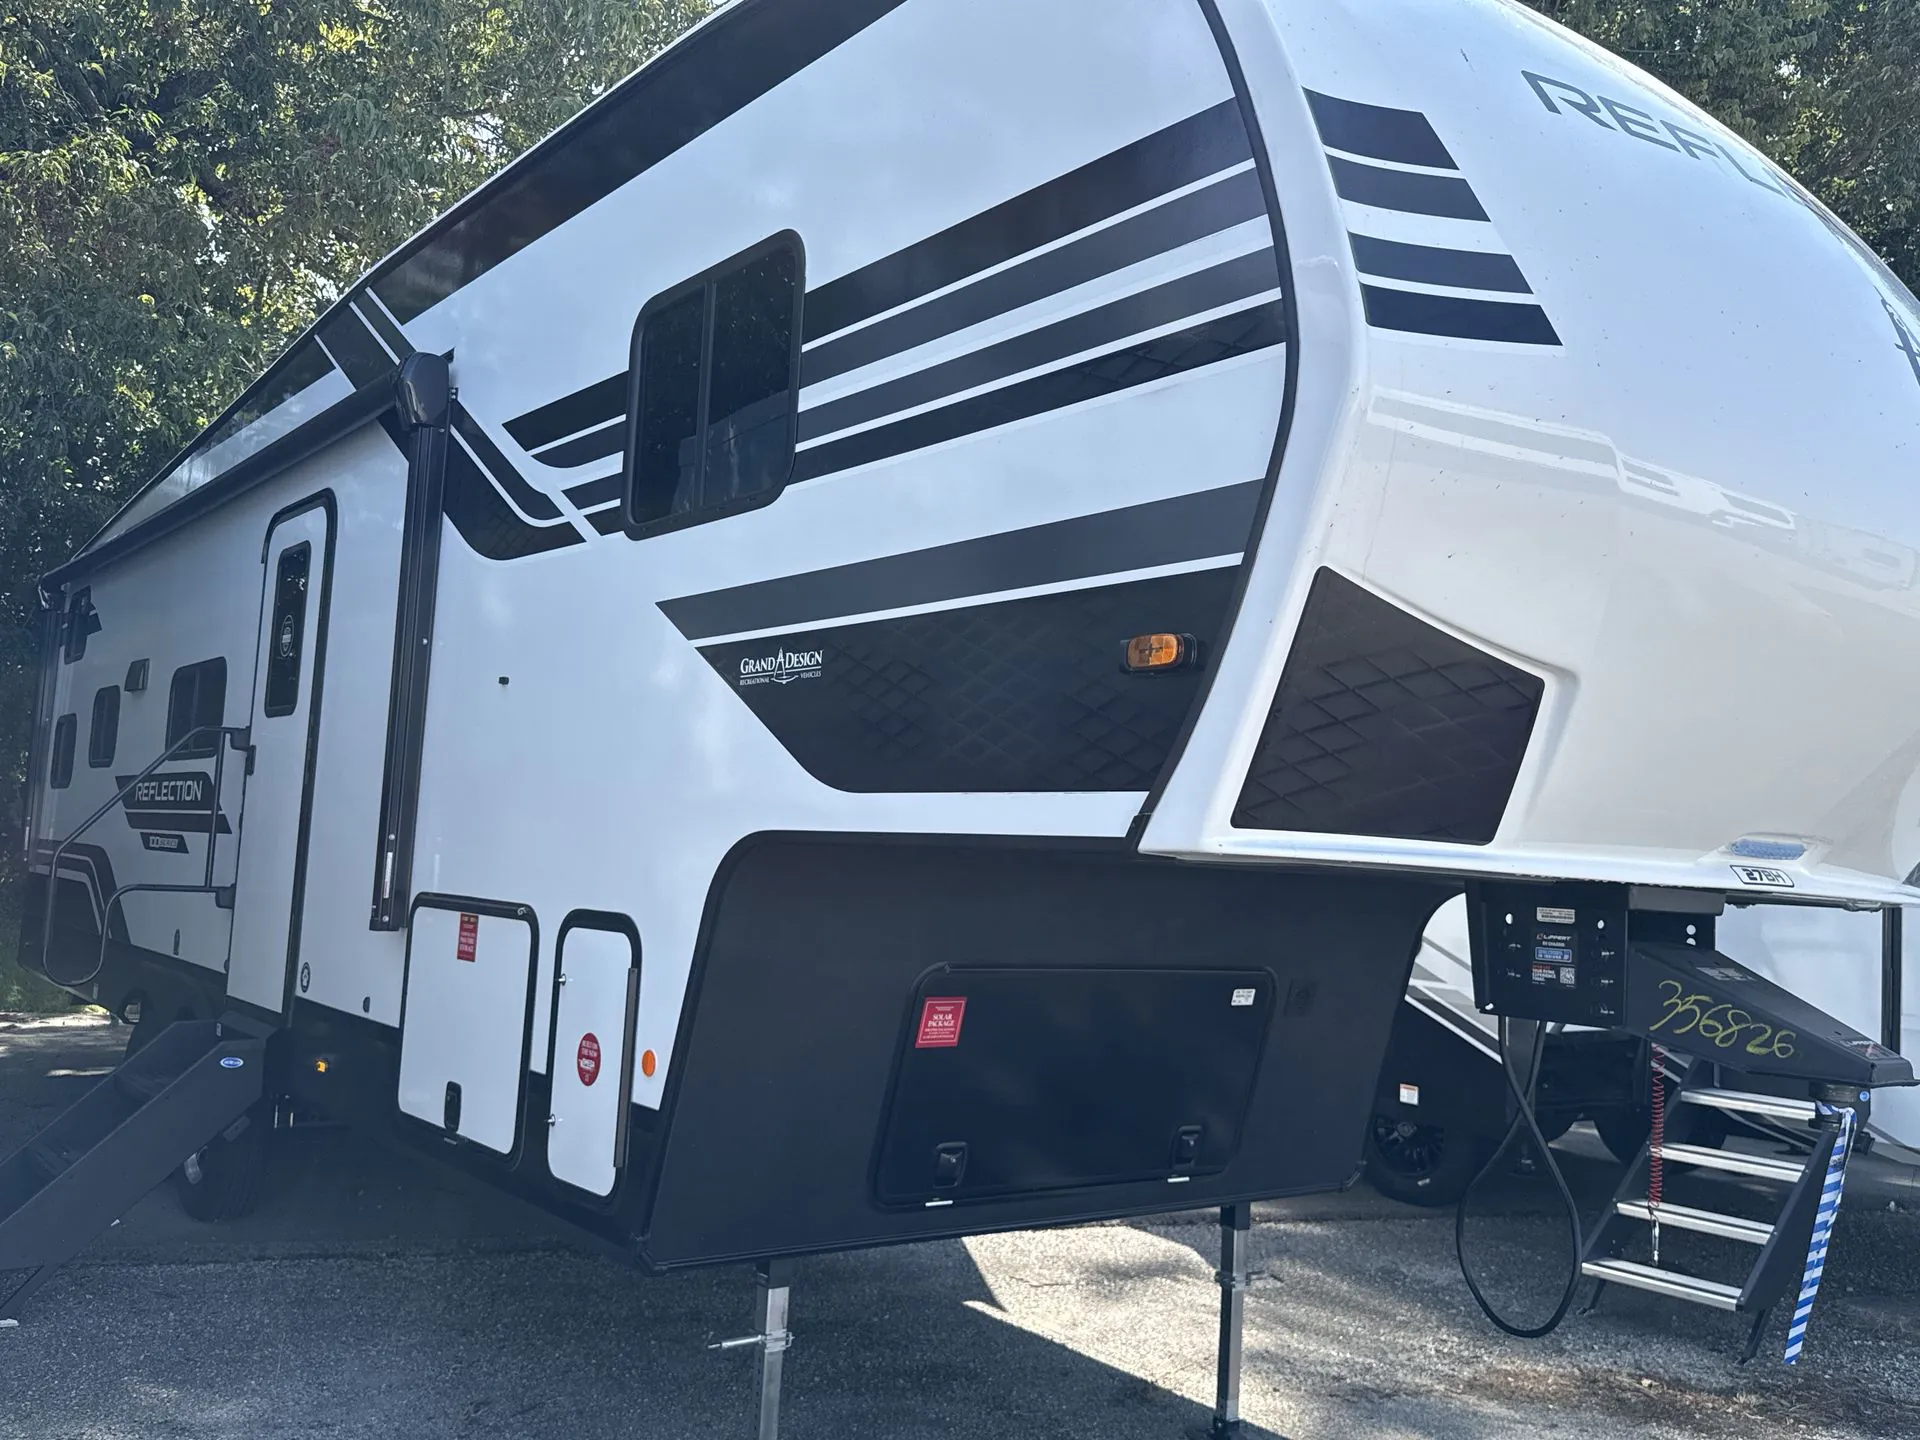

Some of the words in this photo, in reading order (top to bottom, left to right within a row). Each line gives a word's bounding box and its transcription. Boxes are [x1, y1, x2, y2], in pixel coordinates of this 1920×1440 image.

[740, 657, 775, 674] GRAND
[785, 650, 824, 669] DESIGN
[135, 780, 203, 801] REFLECTION
[1741, 868, 1786, 883] 27BH
[1649, 980, 1796, 1058] 356826
